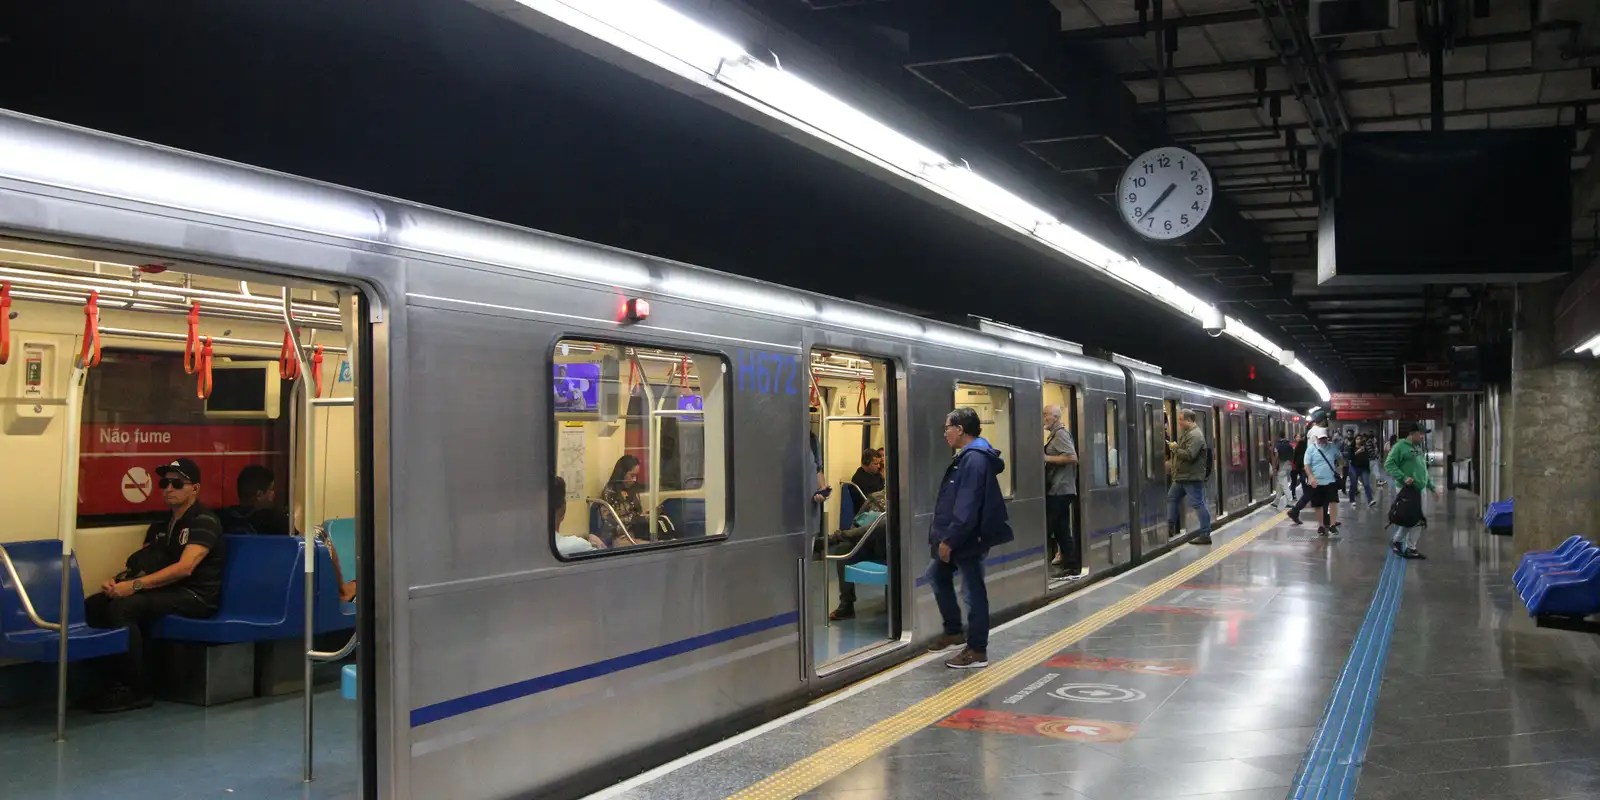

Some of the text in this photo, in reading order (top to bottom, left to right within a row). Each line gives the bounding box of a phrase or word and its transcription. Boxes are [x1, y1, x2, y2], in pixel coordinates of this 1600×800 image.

[1157, 157, 1171, 168] 12
[1178, 160, 1184, 170] 1
[1143, 163, 1154, 174] 11
[1190, 170, 1198, 181] 2
[1132, 177, 1146, 188] 10
[1195, 184, 1204, 196] 3
[1128, 192, 1137, 203] 9
[1134, 206, 1142, 217] 8
[1191, 201, 1199, 212] 4
[1147, 217, 1155, 228] 7
[1180, 213, 1189, 224] 5
[1163, 220, 1172, 231] 6
[738, 349, 798, 395] H672
[100, 428, 171, 443] Não fume
